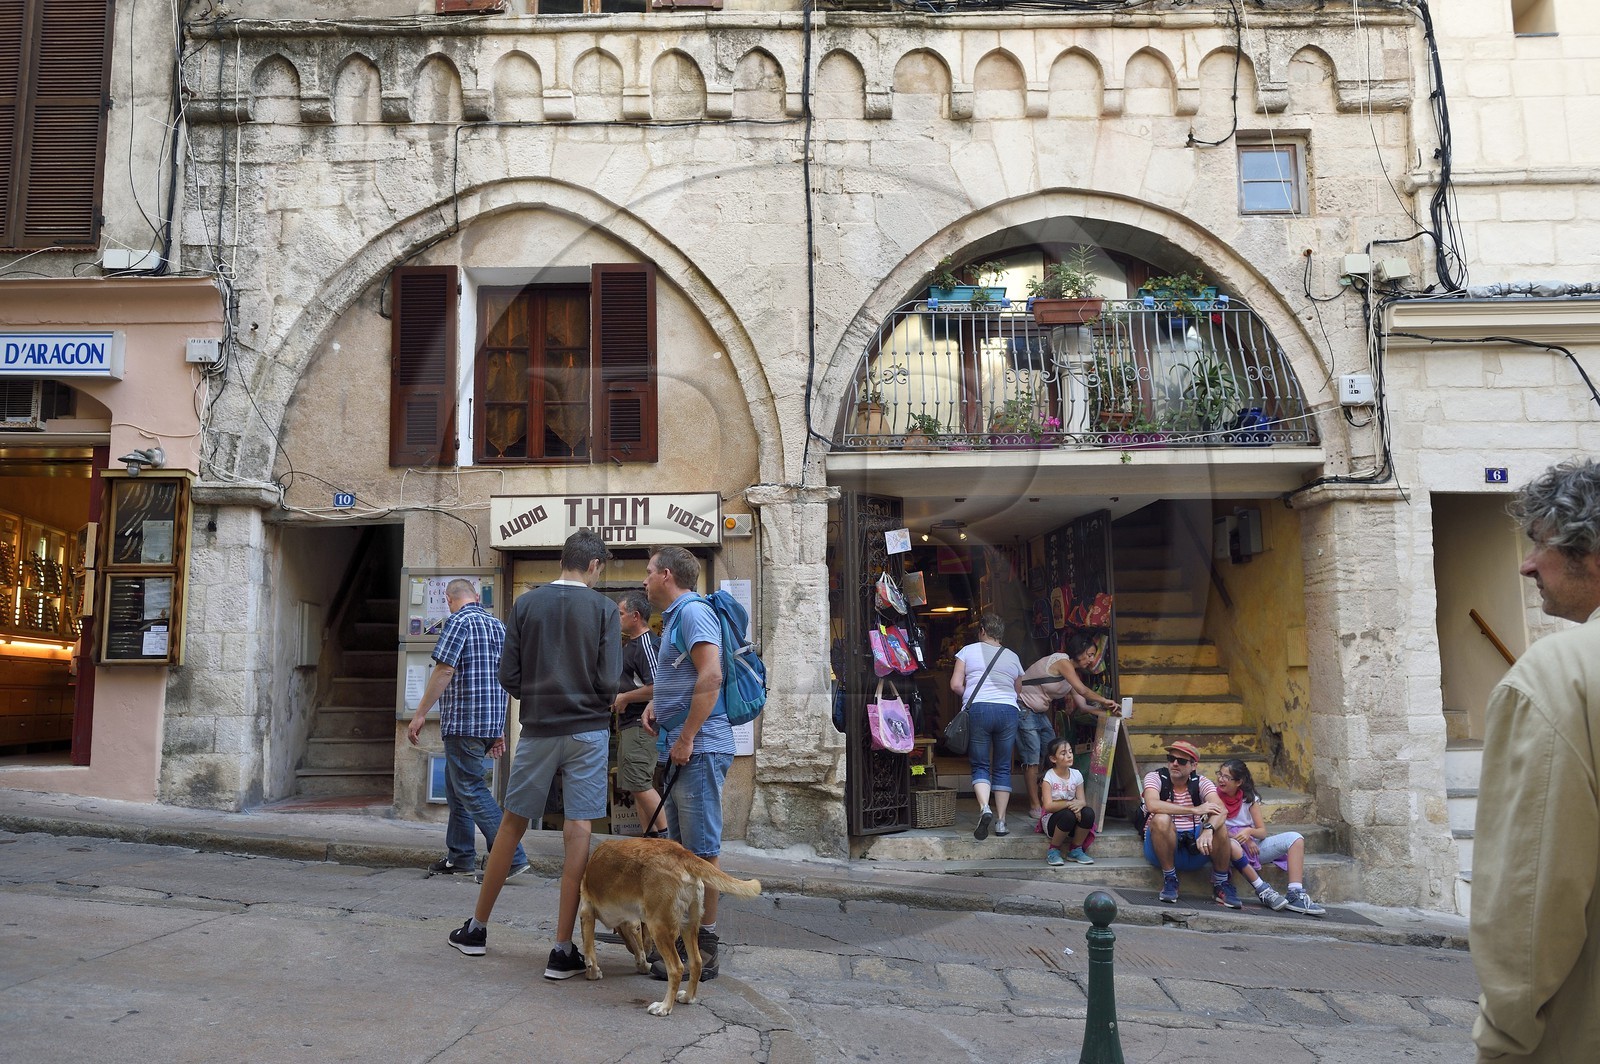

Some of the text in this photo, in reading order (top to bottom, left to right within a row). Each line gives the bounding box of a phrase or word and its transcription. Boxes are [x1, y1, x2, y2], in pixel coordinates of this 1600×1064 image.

[4, 342, 105, 365] D'ARAGON
[1493, 470, 1502, 481] 6
[338, 495, 352, 505] 10
[499, 504, 549, 541] AUDIO
[563, 497, 650, 527] THOM
[666, 503, 715, 538] VIDEO
[579, 526, 637, 542] HOTO
